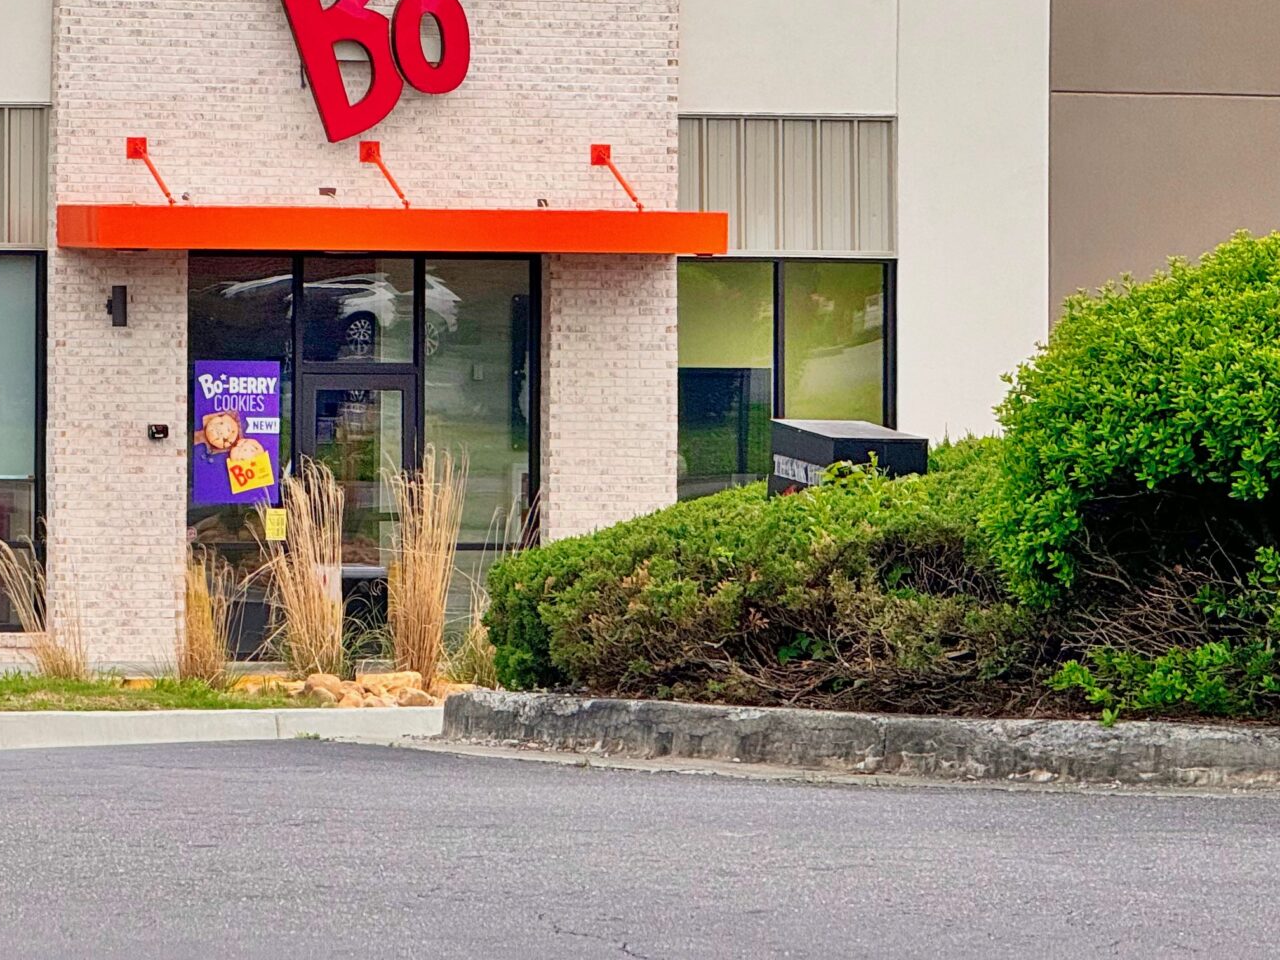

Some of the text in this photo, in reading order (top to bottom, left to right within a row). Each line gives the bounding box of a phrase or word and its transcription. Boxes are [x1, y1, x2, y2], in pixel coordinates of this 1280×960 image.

[198, 373, 277, 399] Bo-BERRY
[214, 395, 265, 412] COOKIES
[252, 420, 277, 431] NEW!
[230, 464, 255, 487] Bo
